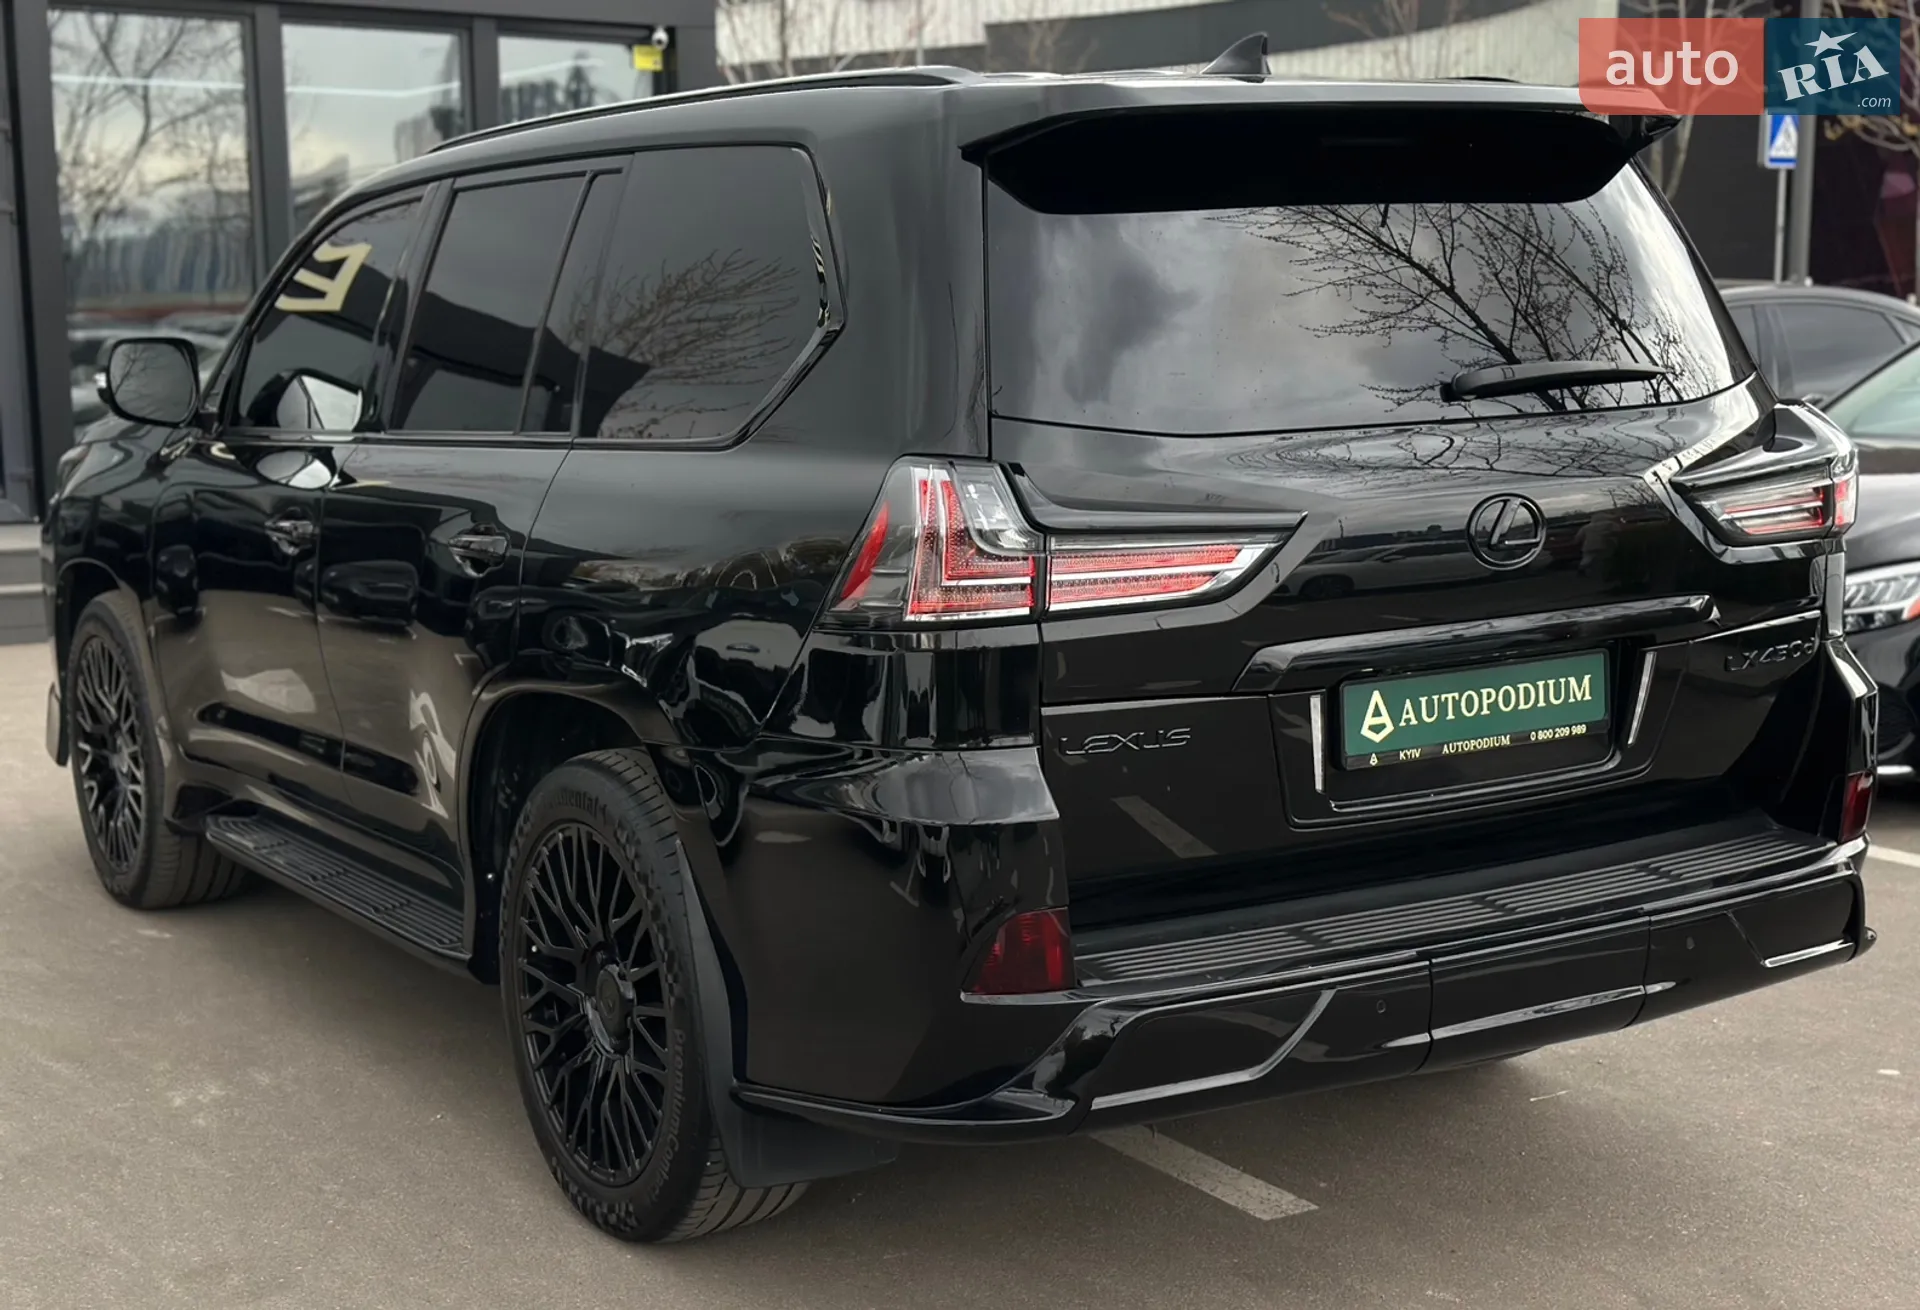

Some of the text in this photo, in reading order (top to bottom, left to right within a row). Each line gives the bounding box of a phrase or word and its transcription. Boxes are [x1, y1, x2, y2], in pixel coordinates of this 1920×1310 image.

[1399, 674, 1592, 727] AUTOPODIUM
[1059, 727, 1191, 755] LEXUS
[1399, 748, 1421, 761] KYIV
[1442, 735, 1511, 755] AUTOPODIUM
[1537, 729, 1554, 740] 800
